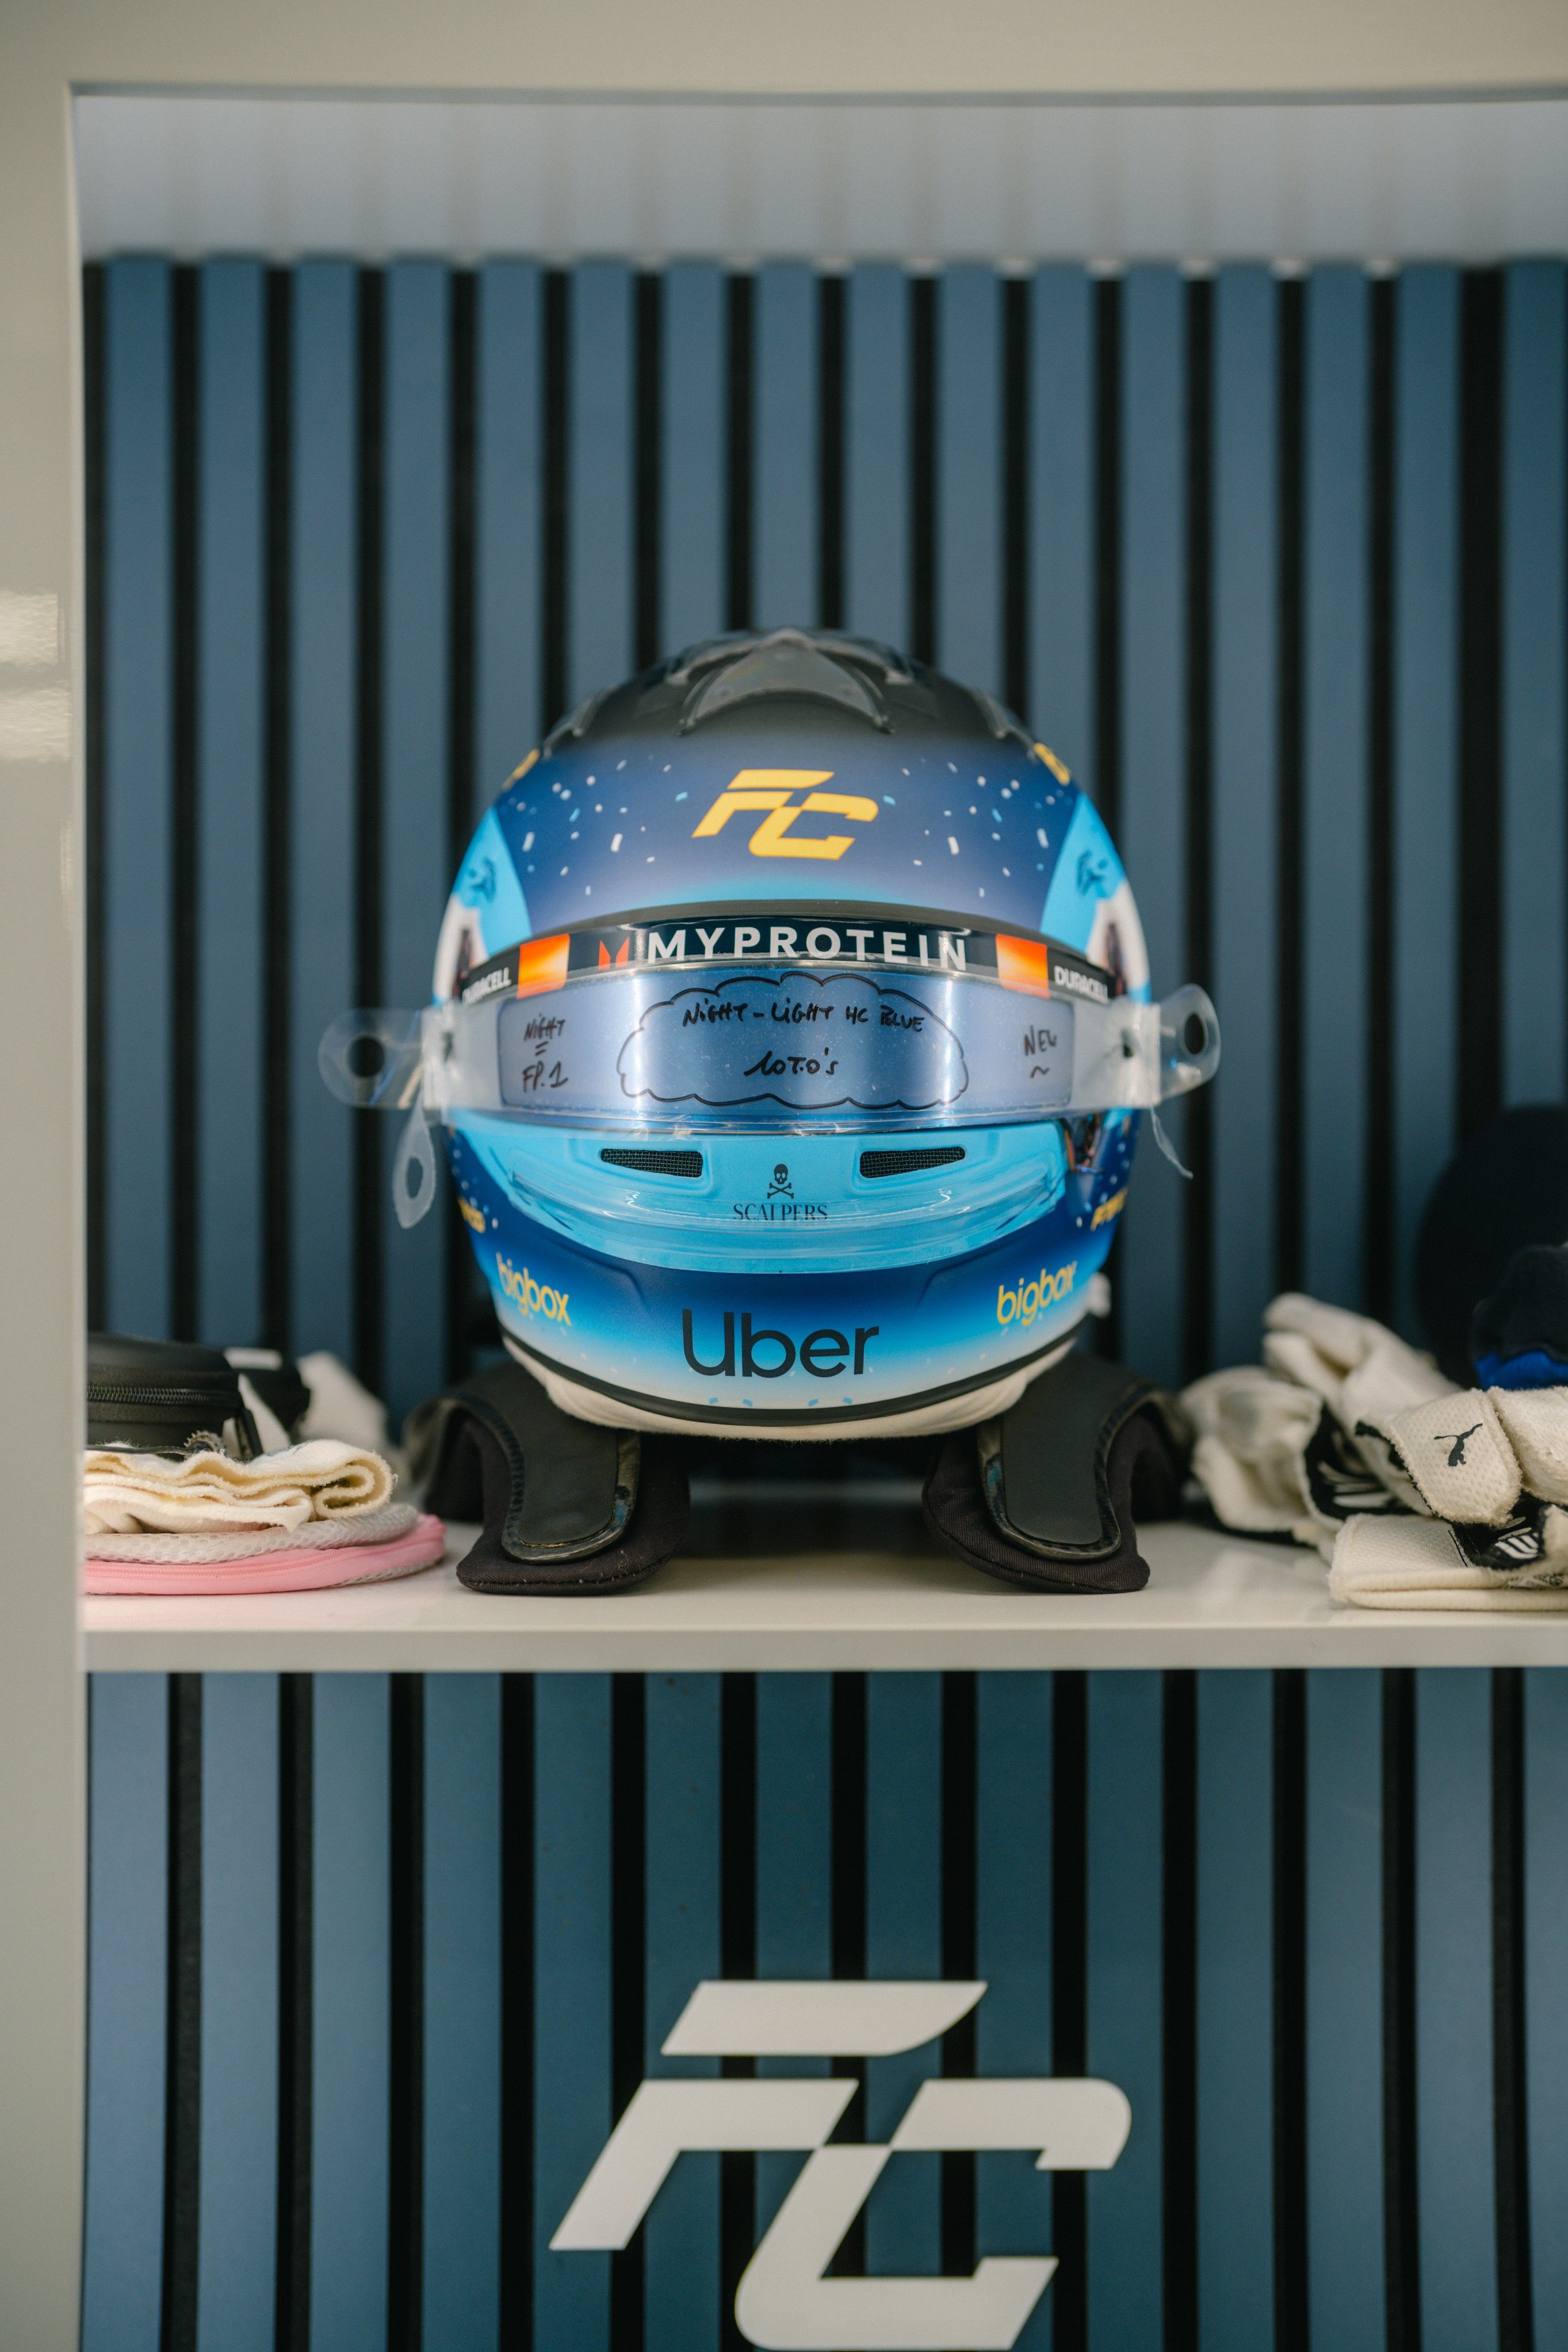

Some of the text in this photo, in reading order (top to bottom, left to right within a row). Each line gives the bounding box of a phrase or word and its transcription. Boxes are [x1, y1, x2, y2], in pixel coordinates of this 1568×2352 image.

[647, 926, 966, 971] MYPROTEIN
[846, 1006, 869, 1024] HC
[880, 1005, 925, 1032] BLUE
[733, 1203, 828, 1221] SCALPERS
[496, 1251, 572, 1326] bigbox
[682, 1308, 880, 1378] Uber
